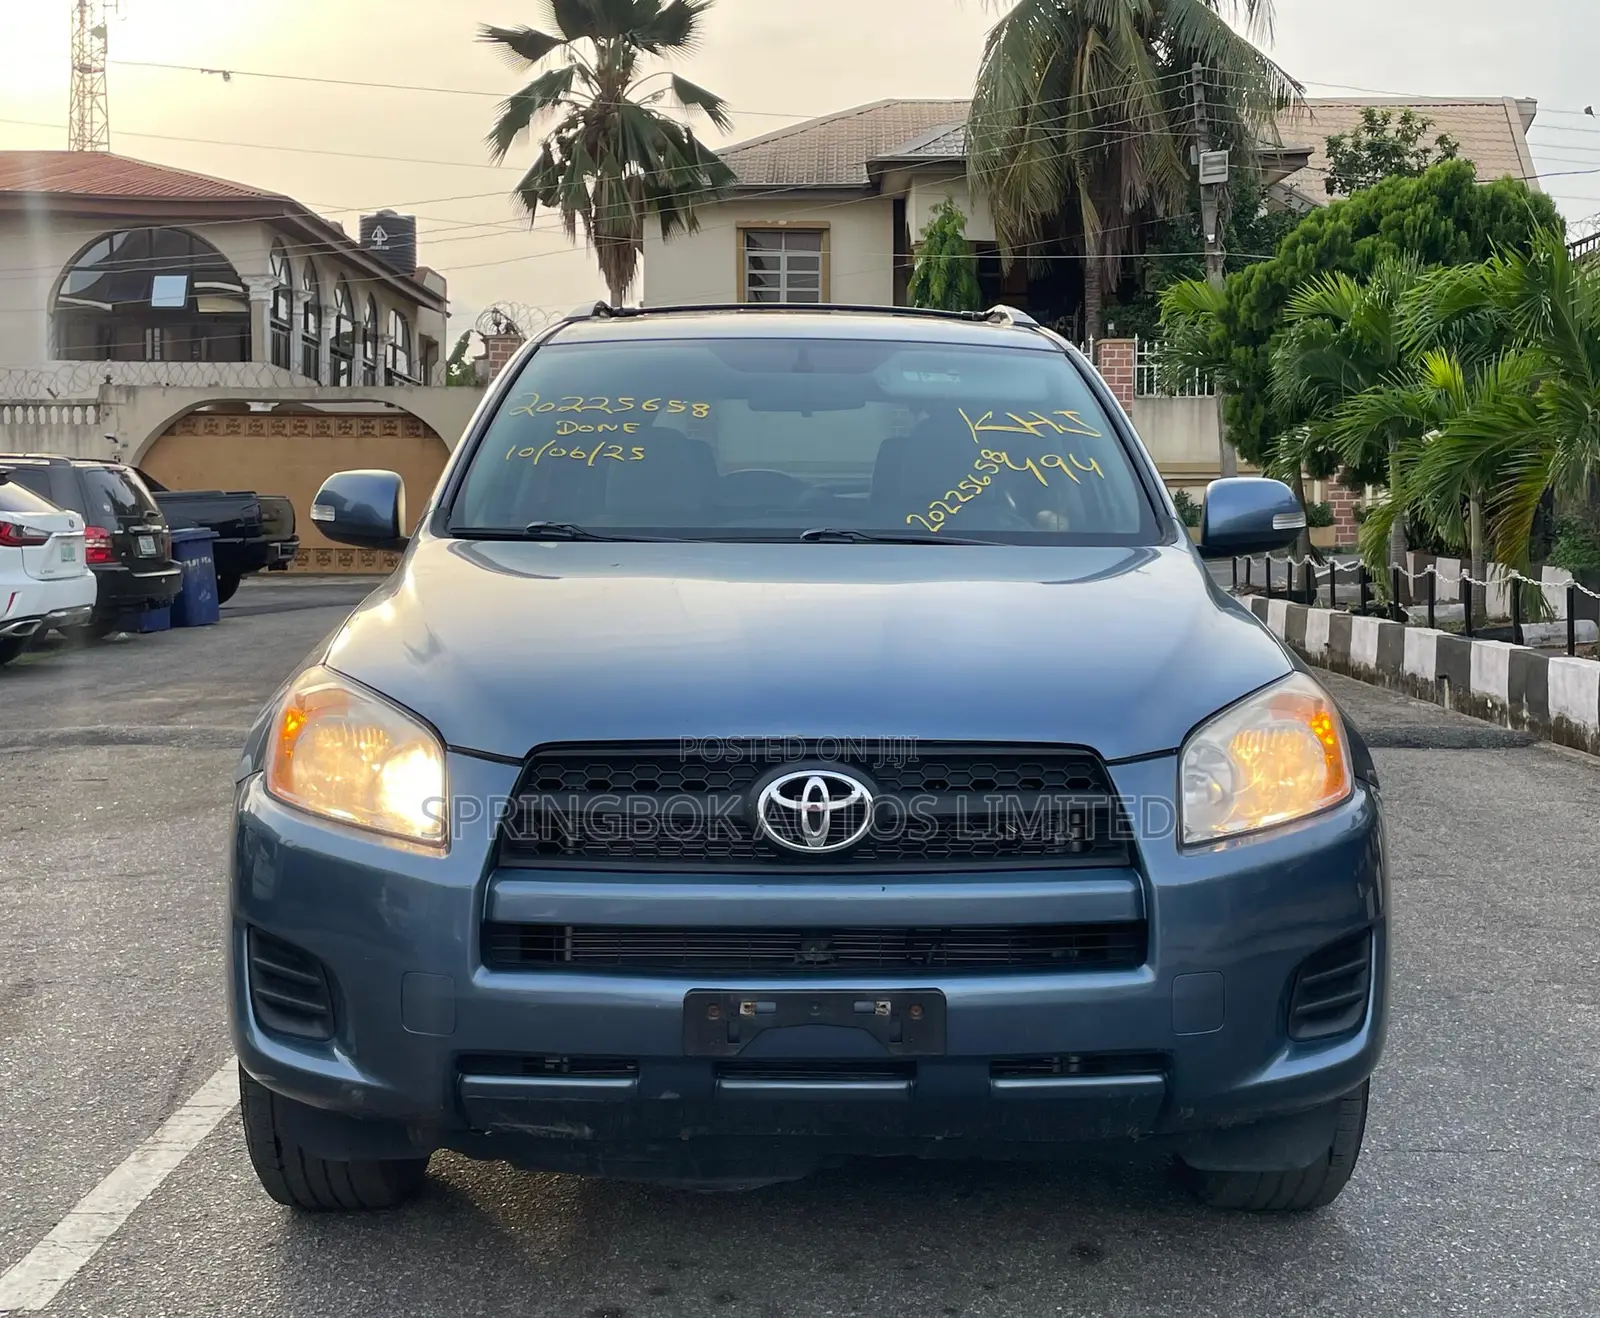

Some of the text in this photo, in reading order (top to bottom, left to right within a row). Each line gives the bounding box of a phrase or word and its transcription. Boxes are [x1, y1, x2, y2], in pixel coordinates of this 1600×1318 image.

[509, 393, 711, 419] 20225658
[555, 420, 641, 436] DONE
[505, 440, 645, 467] 10/06/25
[906, 449, 1005, 533] 20225658
